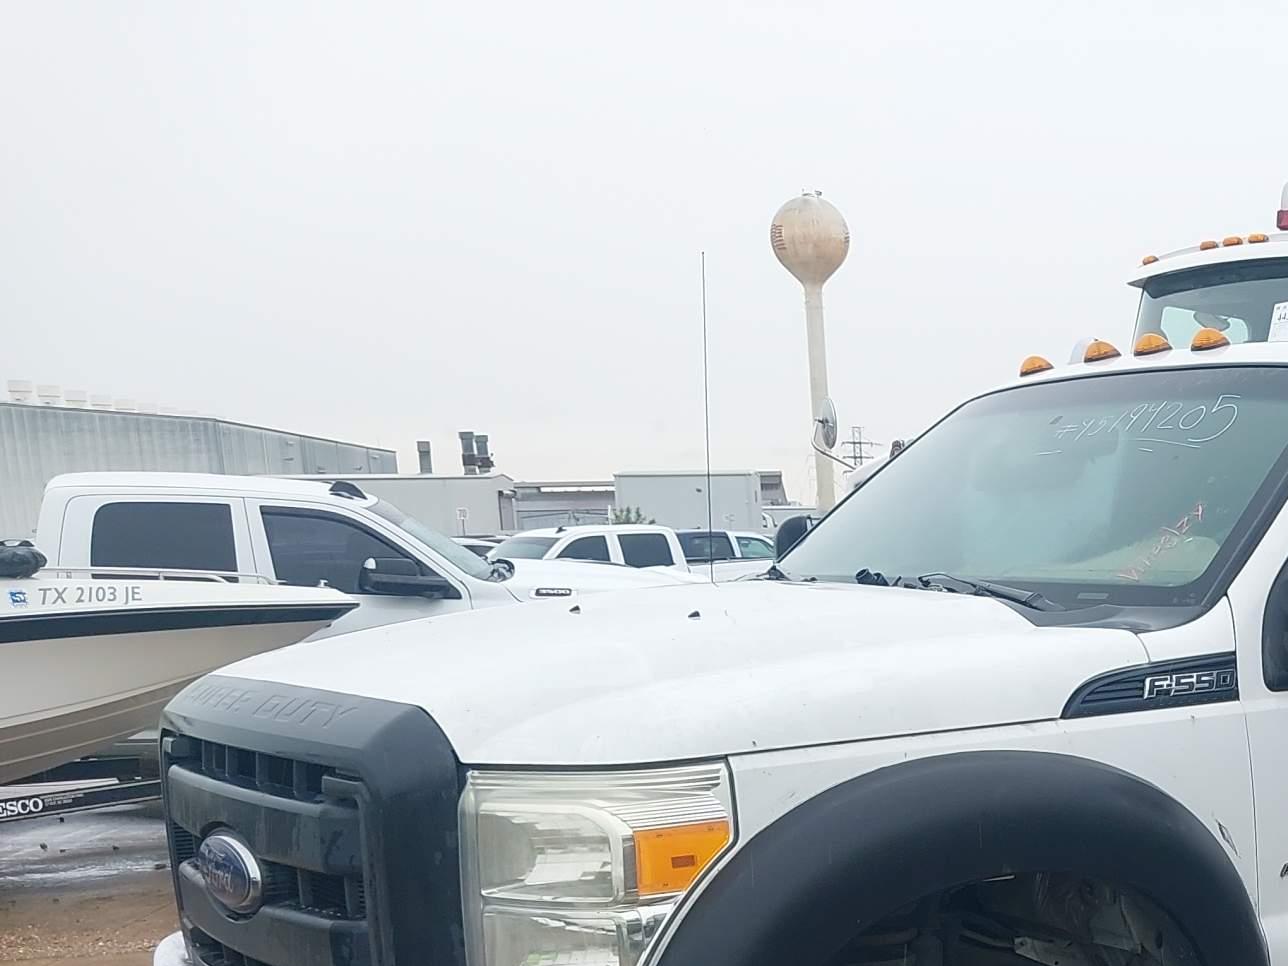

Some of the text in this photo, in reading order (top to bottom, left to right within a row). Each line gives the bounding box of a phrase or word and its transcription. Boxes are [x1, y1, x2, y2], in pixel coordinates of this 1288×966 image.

[38, 586, 143, 605] TX 2103 JE
[1143, 669, 1236, 700] F-550
